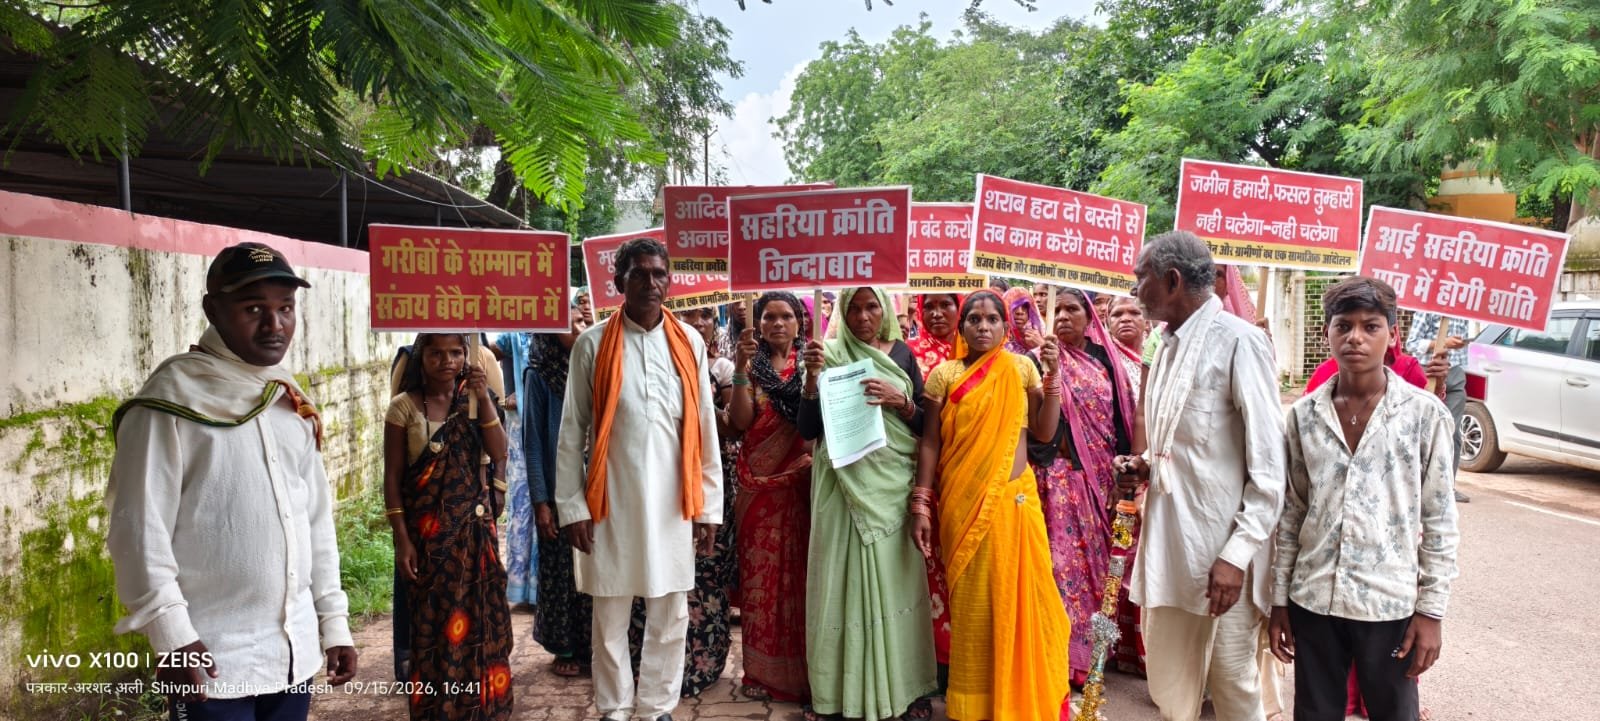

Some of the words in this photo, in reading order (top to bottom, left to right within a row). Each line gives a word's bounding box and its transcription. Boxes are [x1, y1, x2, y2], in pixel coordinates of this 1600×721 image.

[675, 193, 728, 219] आदिव
[1190, 170, 1230, 196] जमीन
[1314, 185, 1353, 215] तुम्हारी
[740, 203, 827, 241] सहरिया
[832, 198, 896, 236] क्रांति
[920, 213, 942, 239] बंद
[984, 190, 1027, 214] शराब
[1030, 197, 1059, 220] हटा
[1063, 197, 1082, 223] दो
[1085, 204, 1123, 231] बस्ती
[1125, 208, 1141, 234] से
[1196, 208, 1223, 233] नही
[1300, 219, 1339, 243] चलेगा
[381, 237, 440, 275] गरीबों
[443, 240, 463, 275] के
[468, 249, 532, 277] सम्मान
[537, 242, 555, 277] में
[677, 230, 729, 248] अनाच
[983, 222, 1007, 244] तब
[1009, 227, 1043, 250] काम
[1046, 227, 1084, 255] करेंगे
[1086, 235, 1120, 262] मस्ती
[1122, 240, 1135, 265] से
[1219, 243, 1233, 256] और
[1264, 249, 1273, 259] का
[1274, 250, 1287, 260] एक
[1375, 223, 1422, 260] आई
[1424, 230, 1500, 269] सहरिया
[1500, 240, 1552, 278] क्रांति
[759, 247, 875, 283] जिन्दाबाद
[923, 249, 955, 268] काम
[976, 253, 994, 269] संजय
[1014, 260, 1028, 273] और
[1057, 268, 1066, 278] का
[1068, 269, 1079, 281] एक
[909, 276, 956, 287] सामाजिक
[958, 276, 984, 287] संस्था
[1414, 268, 1437, 303] में
[1436, 272, 1486, 311] होगी
[1488, 282, 1538, 320] शांति
[376, 284, 431, 320] संजय
[435, 285, 481, 320] बेचैन
[487, 286, 538, 320] मैदान
[544, 287, 562, 321] में
